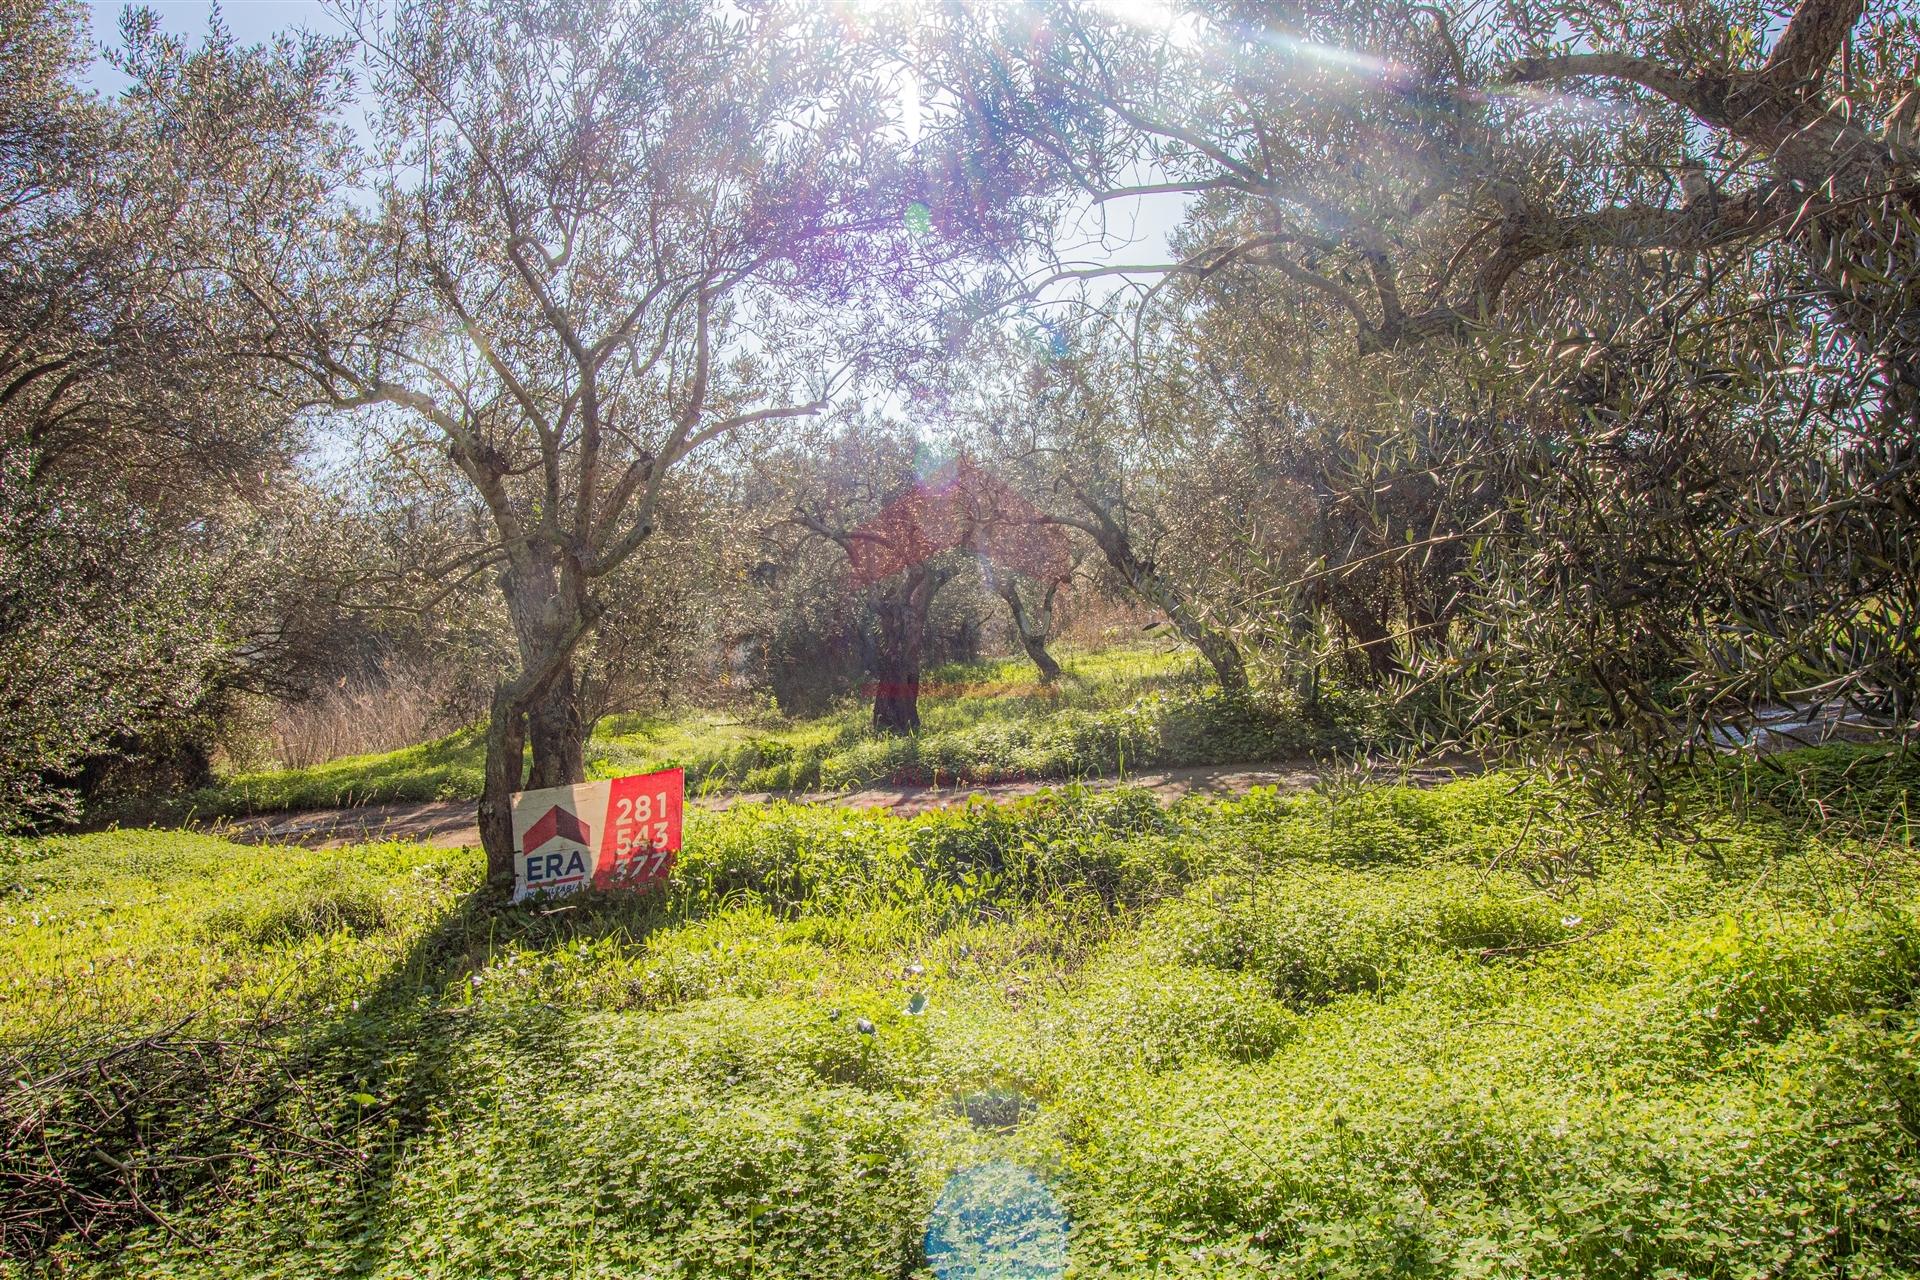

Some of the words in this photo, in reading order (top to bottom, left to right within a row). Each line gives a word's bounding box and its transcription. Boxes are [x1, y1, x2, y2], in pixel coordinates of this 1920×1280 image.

[616, 791, 667, 826] 281
[616, 820, 669, 855] 543
[526, 850, 586, 882] ERA
